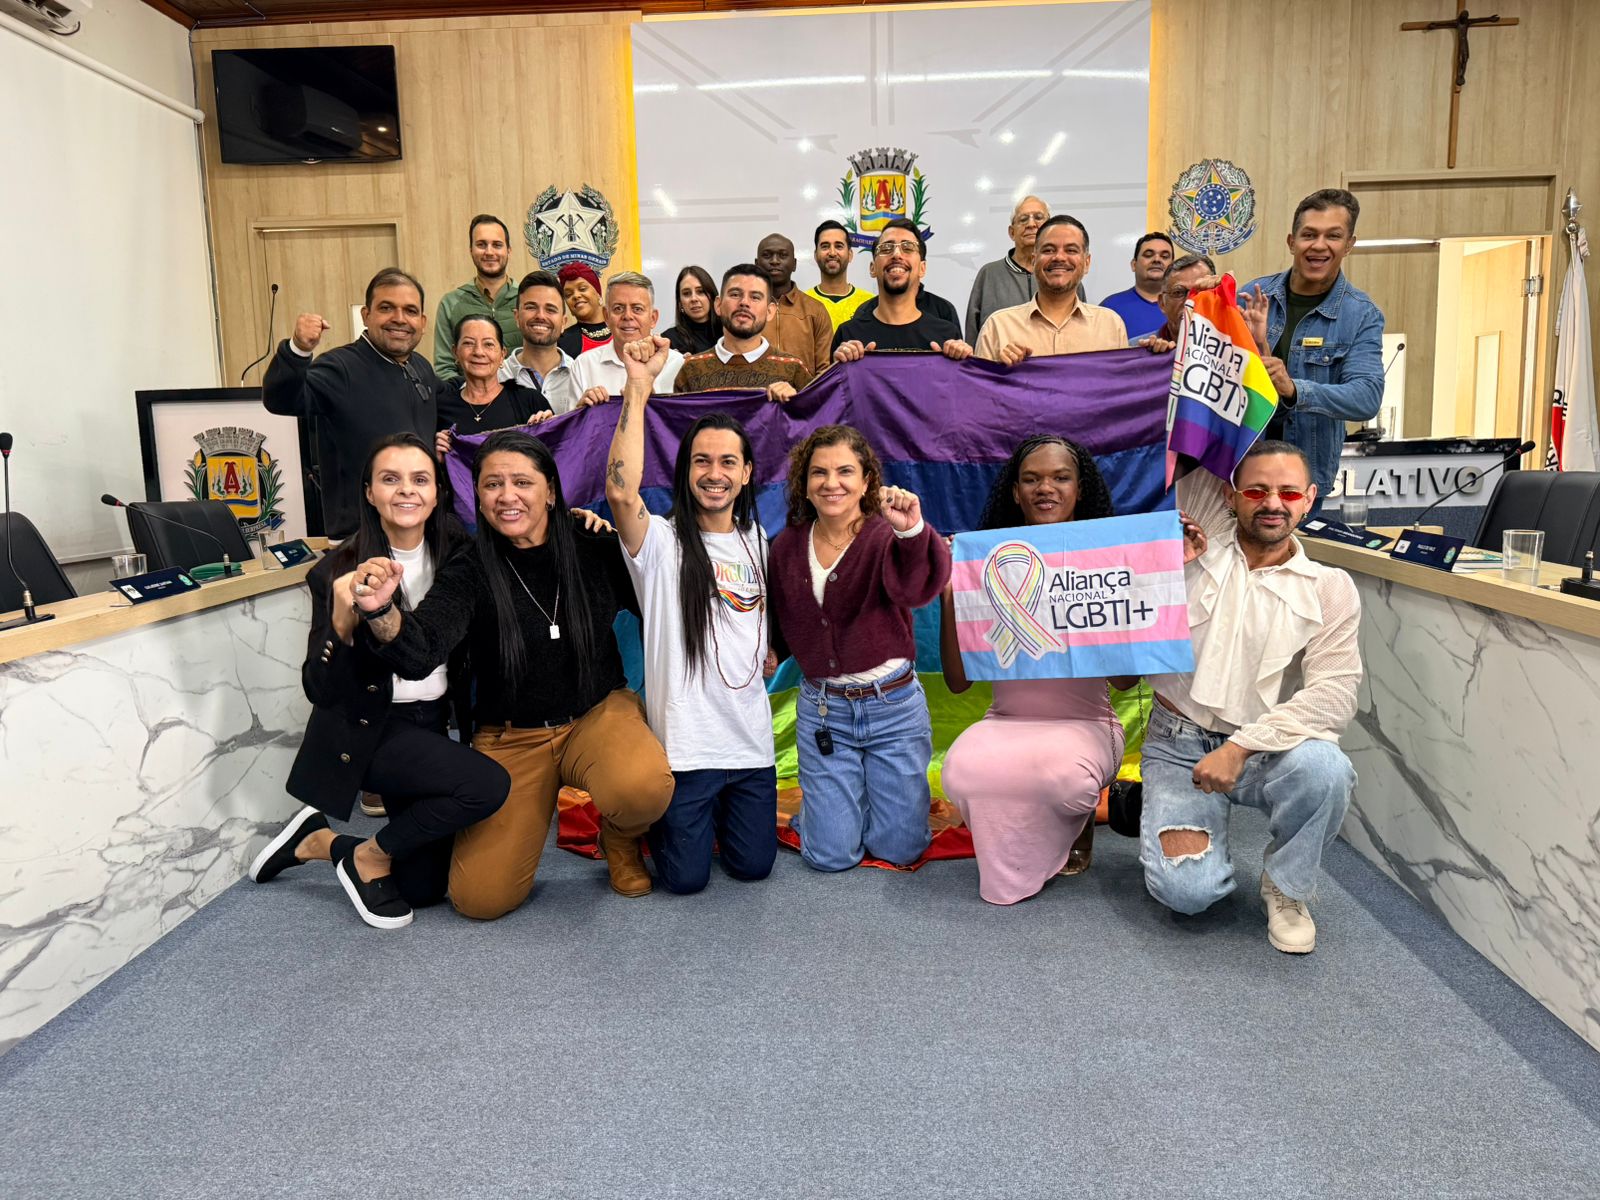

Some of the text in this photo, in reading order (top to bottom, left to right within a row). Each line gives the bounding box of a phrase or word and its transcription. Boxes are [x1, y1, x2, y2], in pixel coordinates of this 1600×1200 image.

[541, 256, 562, 267] ESTADO
[588, 255, 608, 265] GERAIS
[1188, 320, 1244, 374] Aliana
[1185, 346, 1233, 378] ACIONAL
[1049, 570, 1131, 593] Aliança
[1049, 591, 1108, 603] NACIONAL
[1050, 599, 1154, 630] LGBTI+
